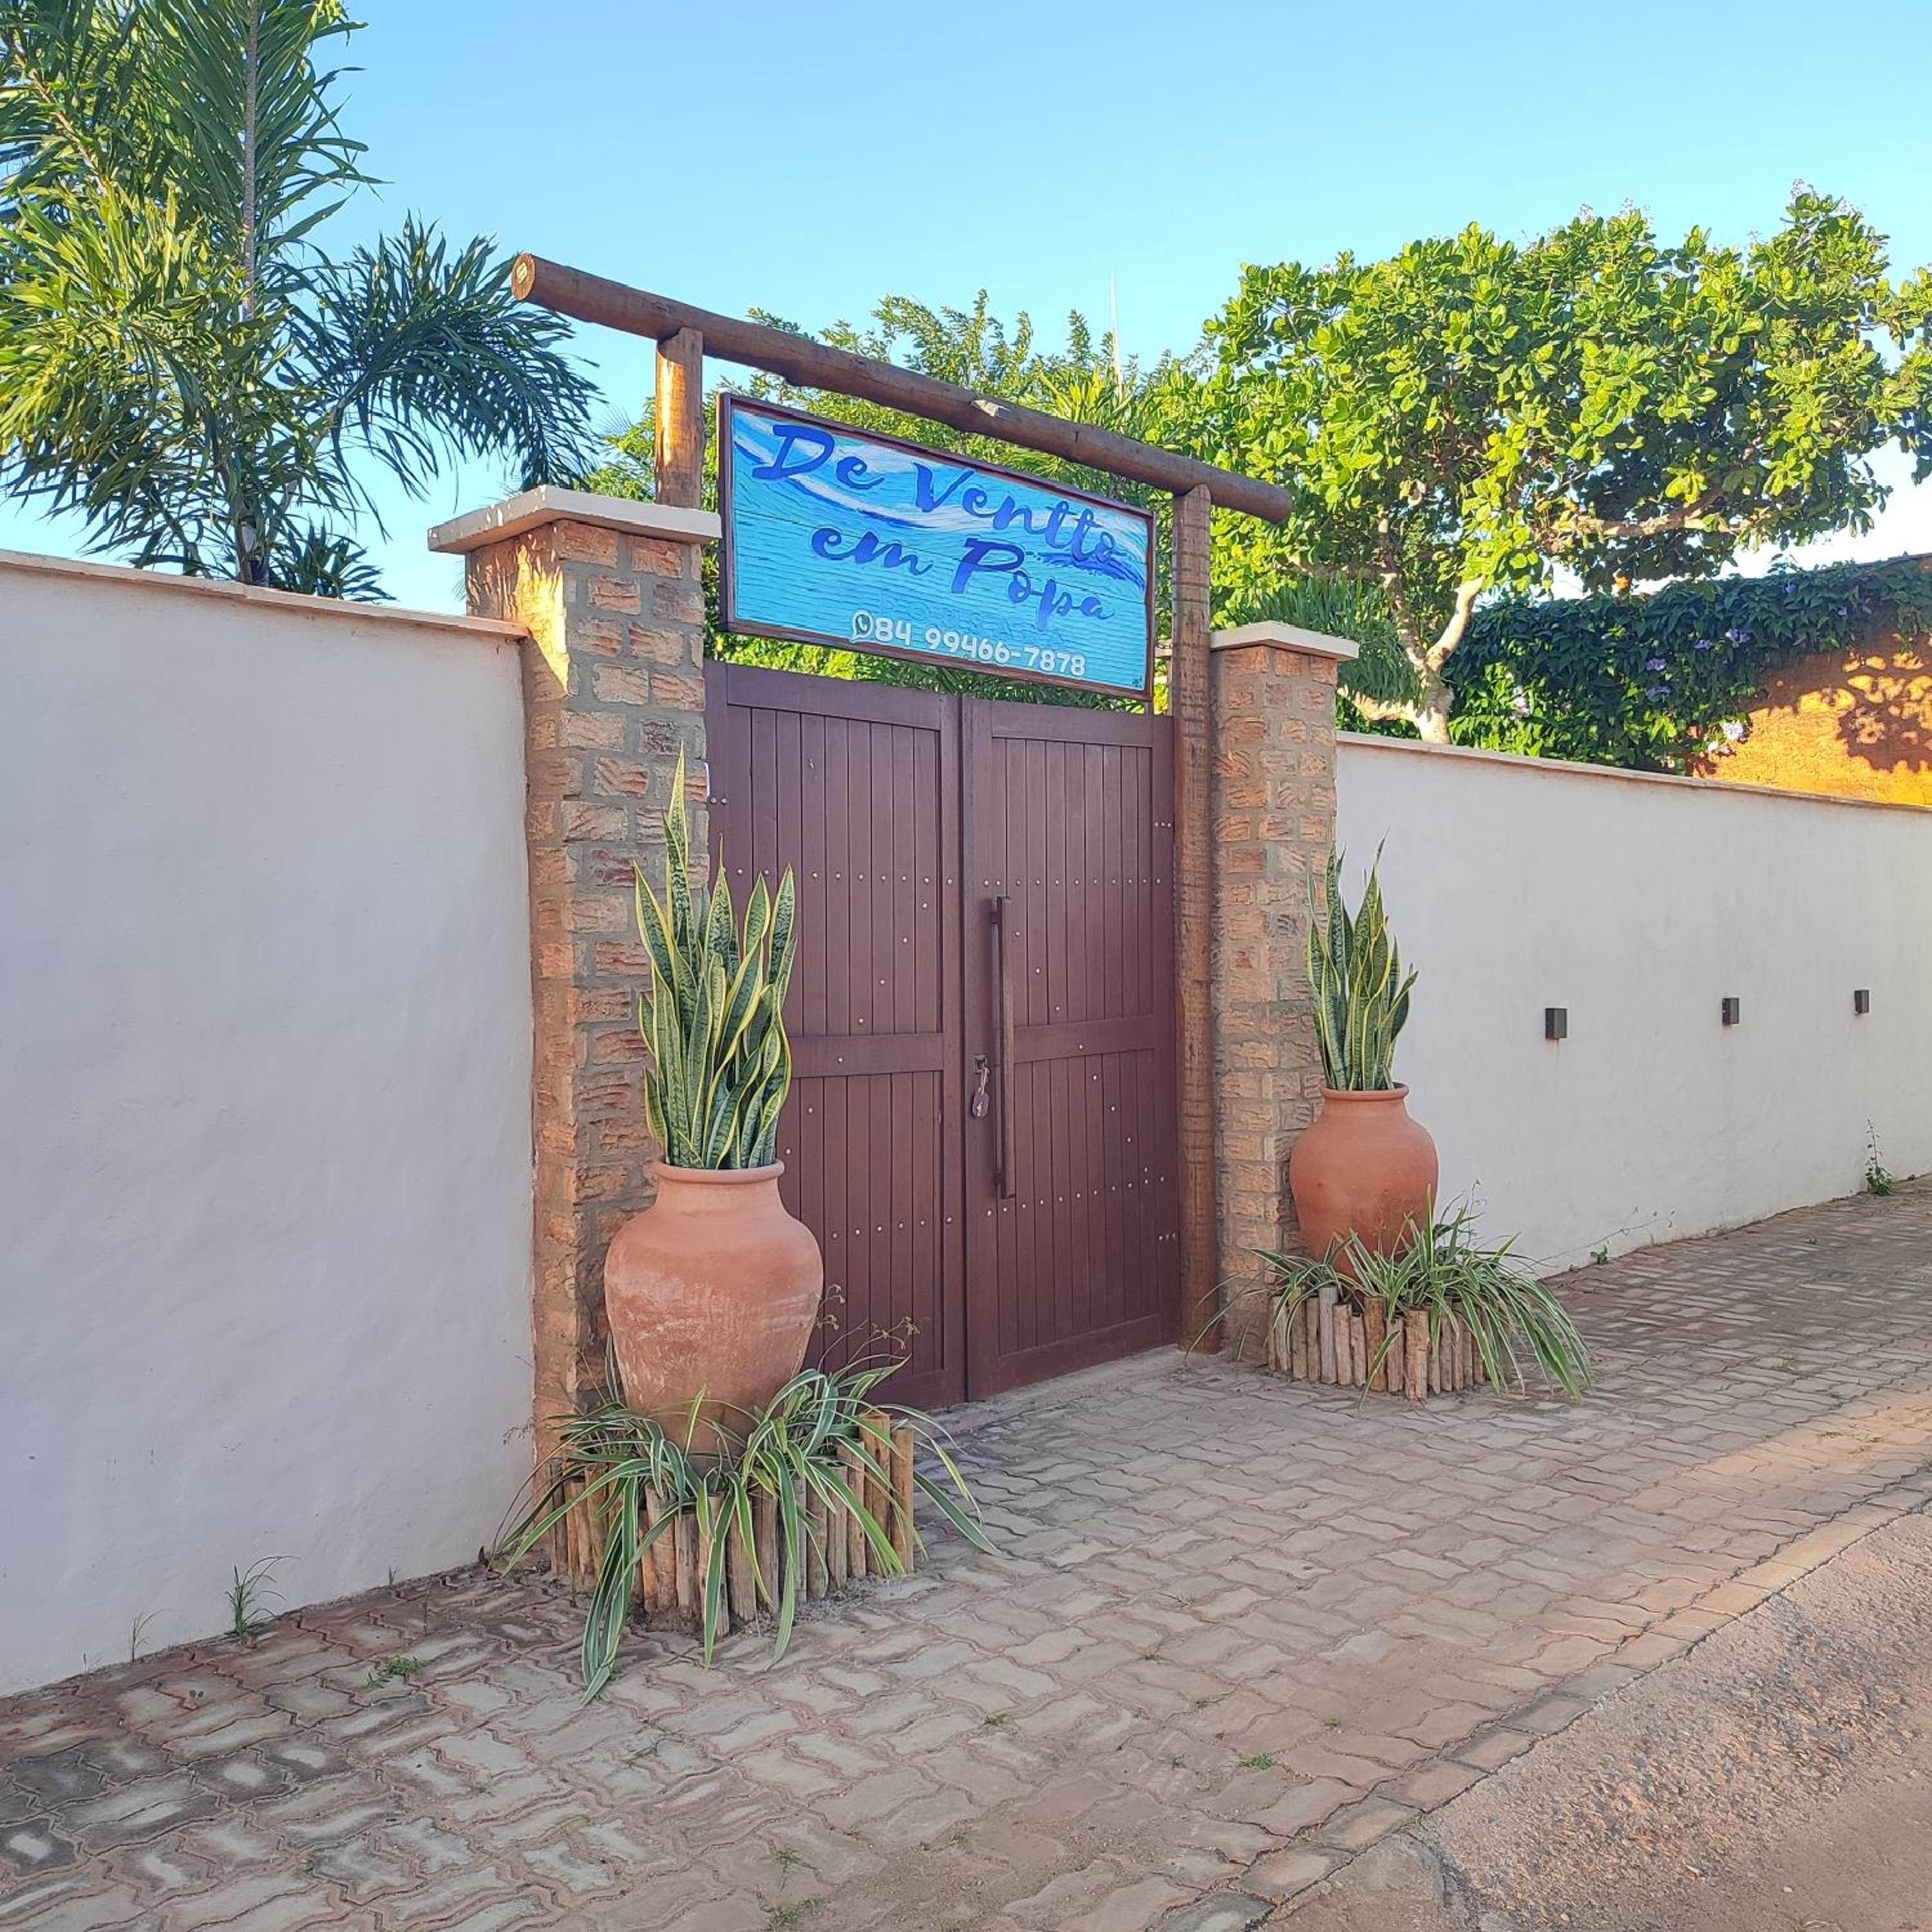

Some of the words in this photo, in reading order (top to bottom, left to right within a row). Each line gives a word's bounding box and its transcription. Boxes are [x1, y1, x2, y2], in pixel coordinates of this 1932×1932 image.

[752, 424, 885, 490] De
[913, 462, 1128, 563] Ventto
[811, 527, 934, 576] em
[951, 537, 1115, 632] Popa
[875, 617, 911, 646] 84
[925, 627, 1086, 676] 99466-7878
